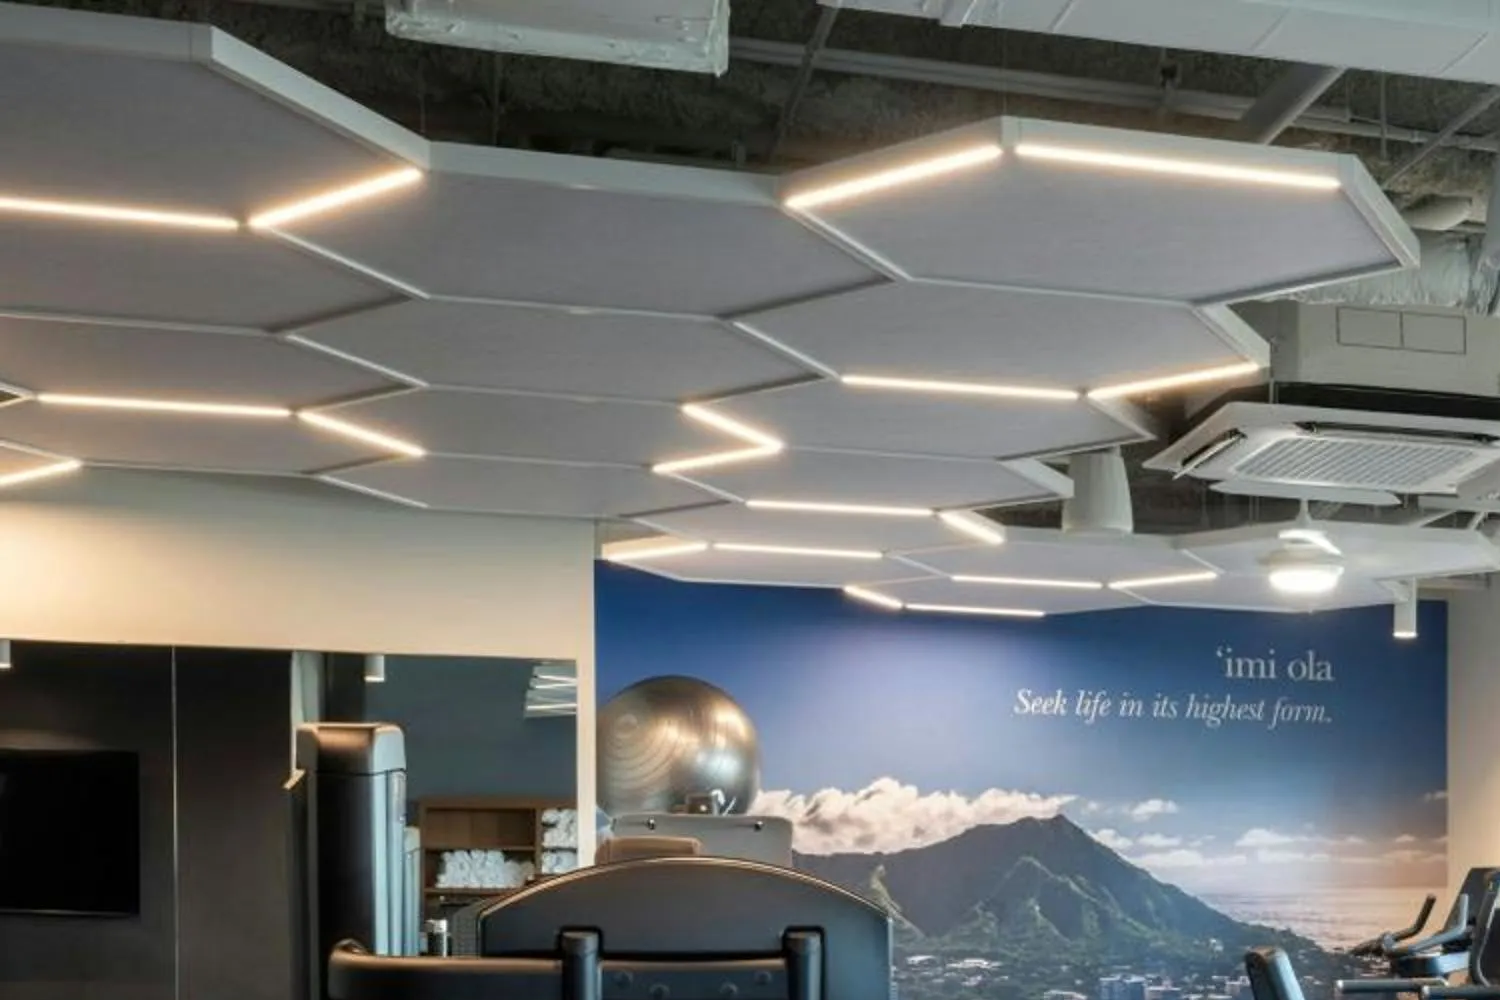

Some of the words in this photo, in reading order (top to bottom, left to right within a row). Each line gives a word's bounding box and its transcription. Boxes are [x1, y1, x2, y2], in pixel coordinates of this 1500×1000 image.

[1288, 650, 1334, 681] ola
[1013, 688, 1068, 715] Seek
[1075, 690, 1110, 724] life
[1120, 692, 1144, 716] in
[1152, 693, 1178, 718] its
[1186, 693, 1264, 727] highest
[1269, 697, 1333, 728] form.
